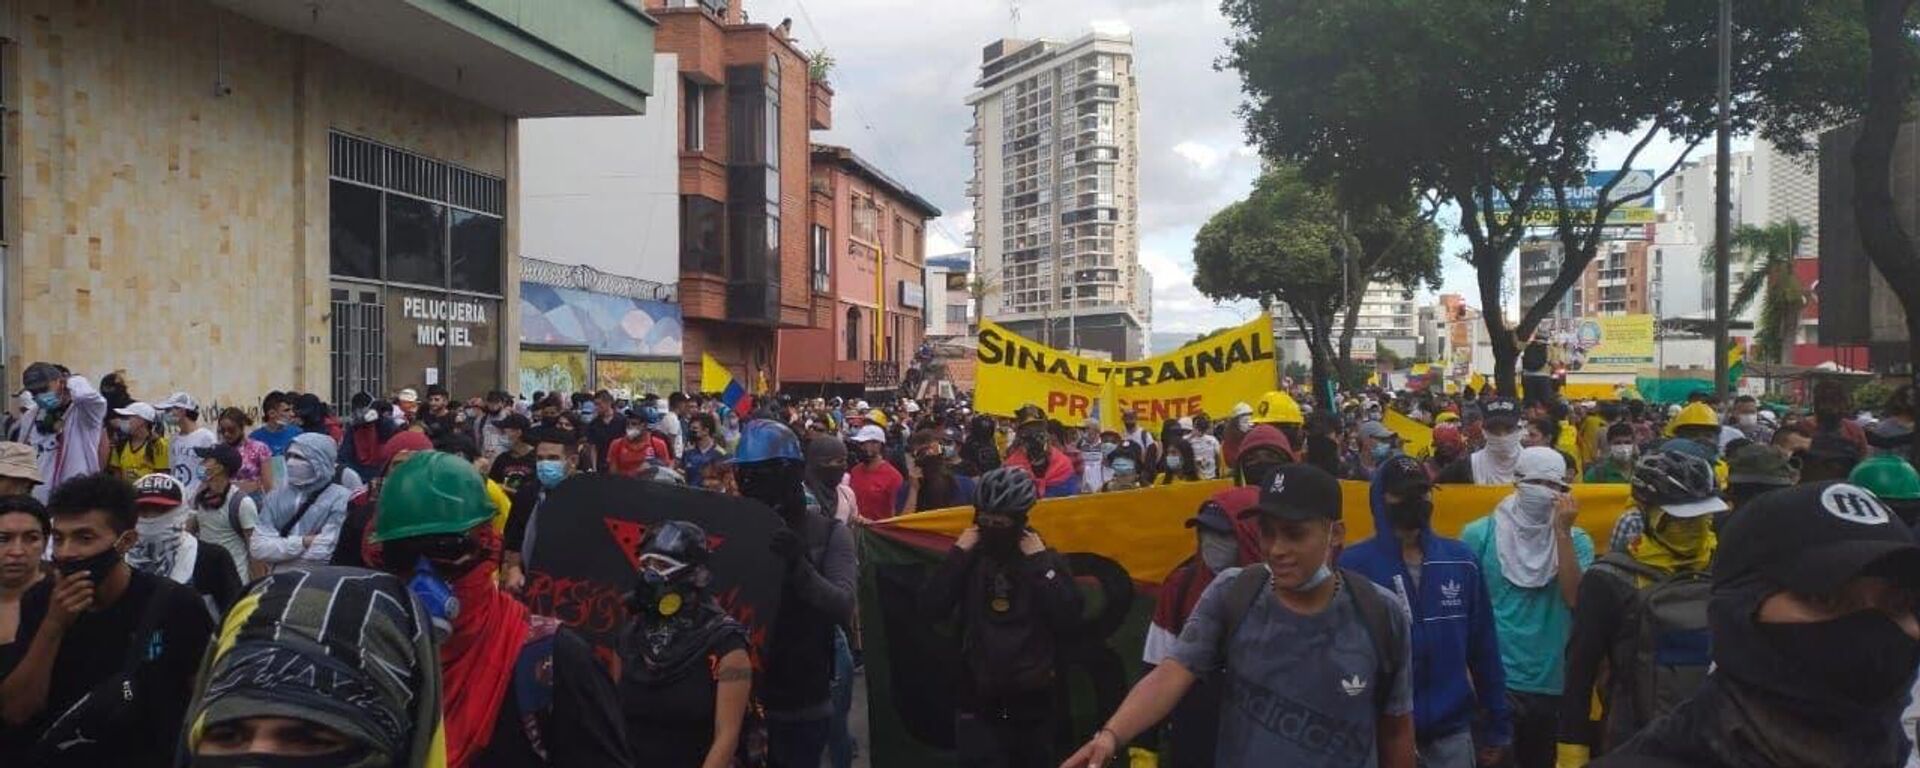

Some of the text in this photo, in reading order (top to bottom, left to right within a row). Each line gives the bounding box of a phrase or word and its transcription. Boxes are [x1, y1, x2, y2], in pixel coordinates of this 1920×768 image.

[403, 297, 486, 324] PELUQUERÍA
[417, 324, 473, 347] MICHEL
[976, 328, 1274, 388] SINALTRAINAL
[1047, 391, 1202, 422] PRSENTE
